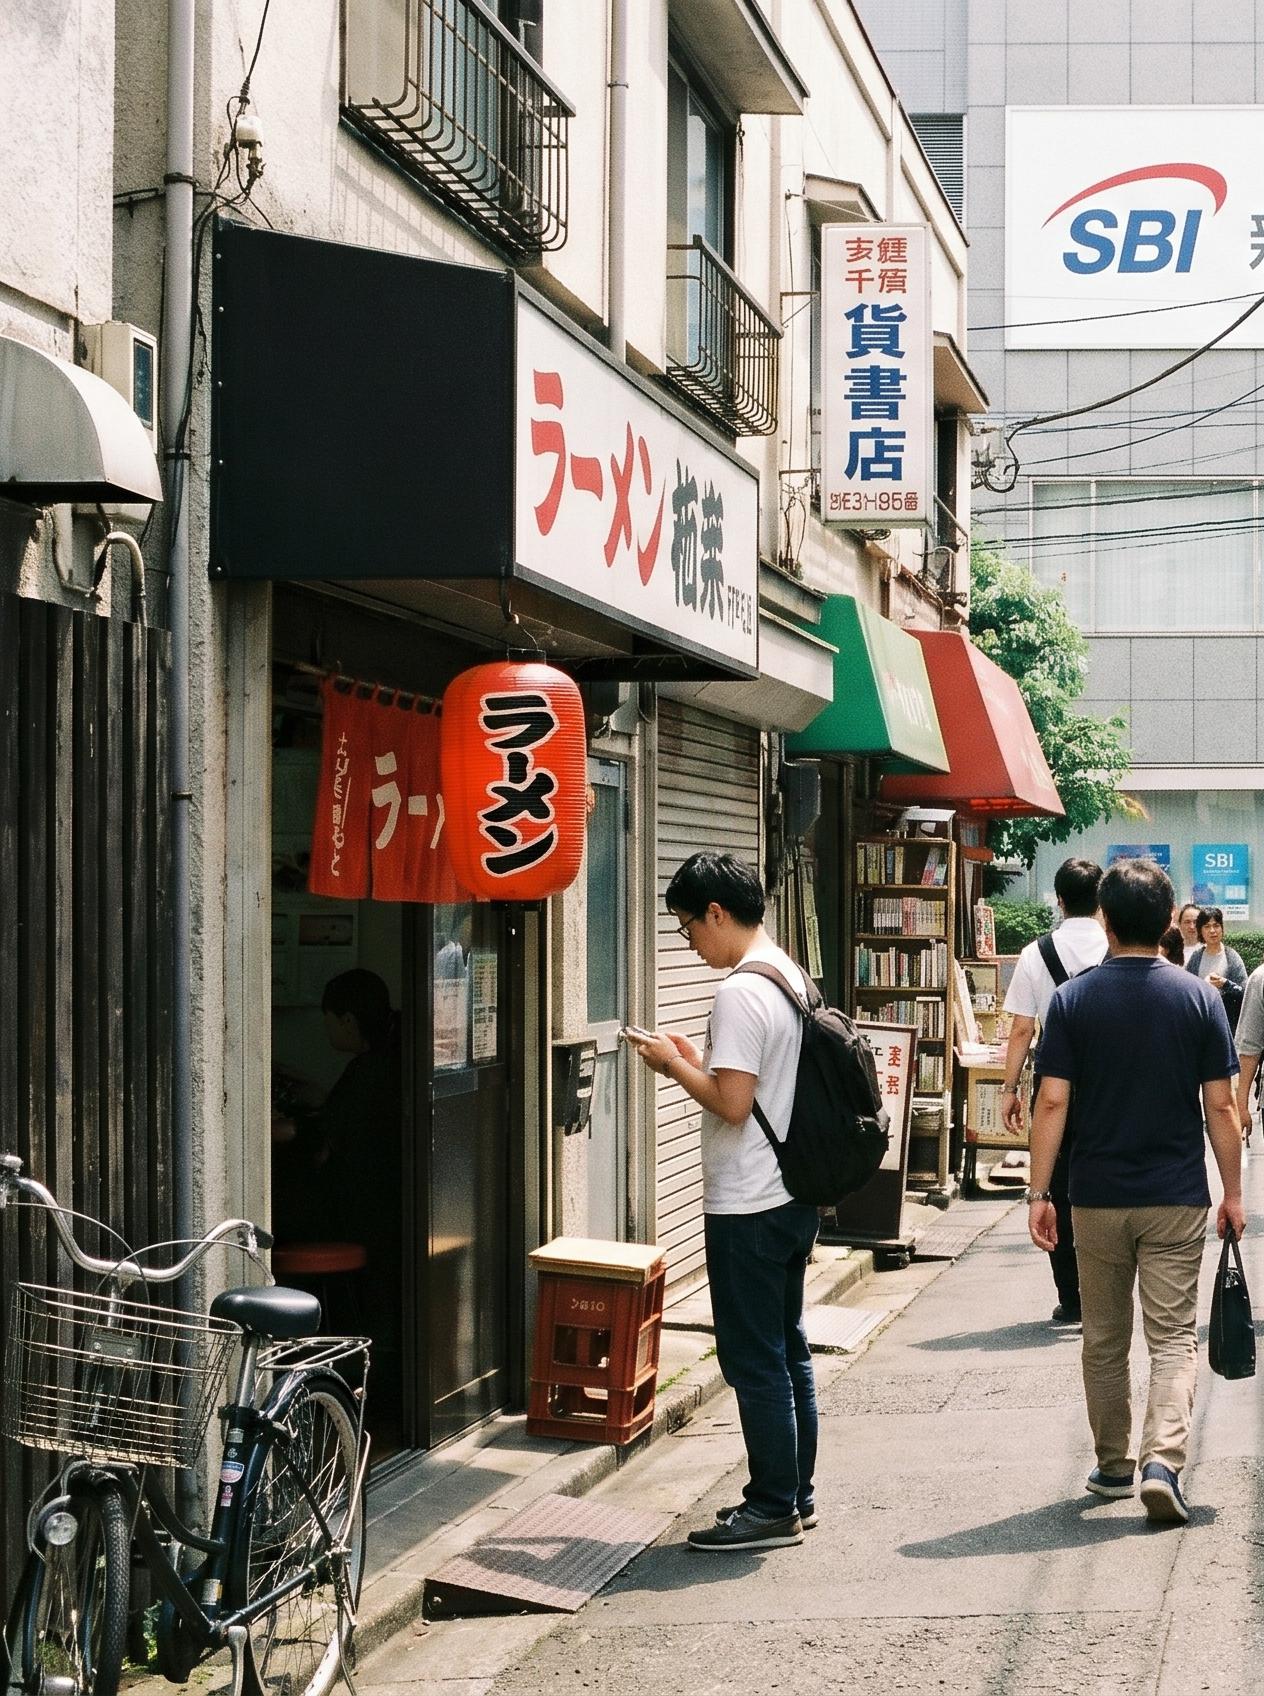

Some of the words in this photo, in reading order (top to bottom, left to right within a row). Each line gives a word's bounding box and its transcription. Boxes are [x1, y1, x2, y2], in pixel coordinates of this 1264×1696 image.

[1063, 209, 1203, 274] SBI
[530, 369, 666, 587] ラーメン
[477, 691, 561, 877] ラーメン
[1204, 853, 1234, 868] SBI
